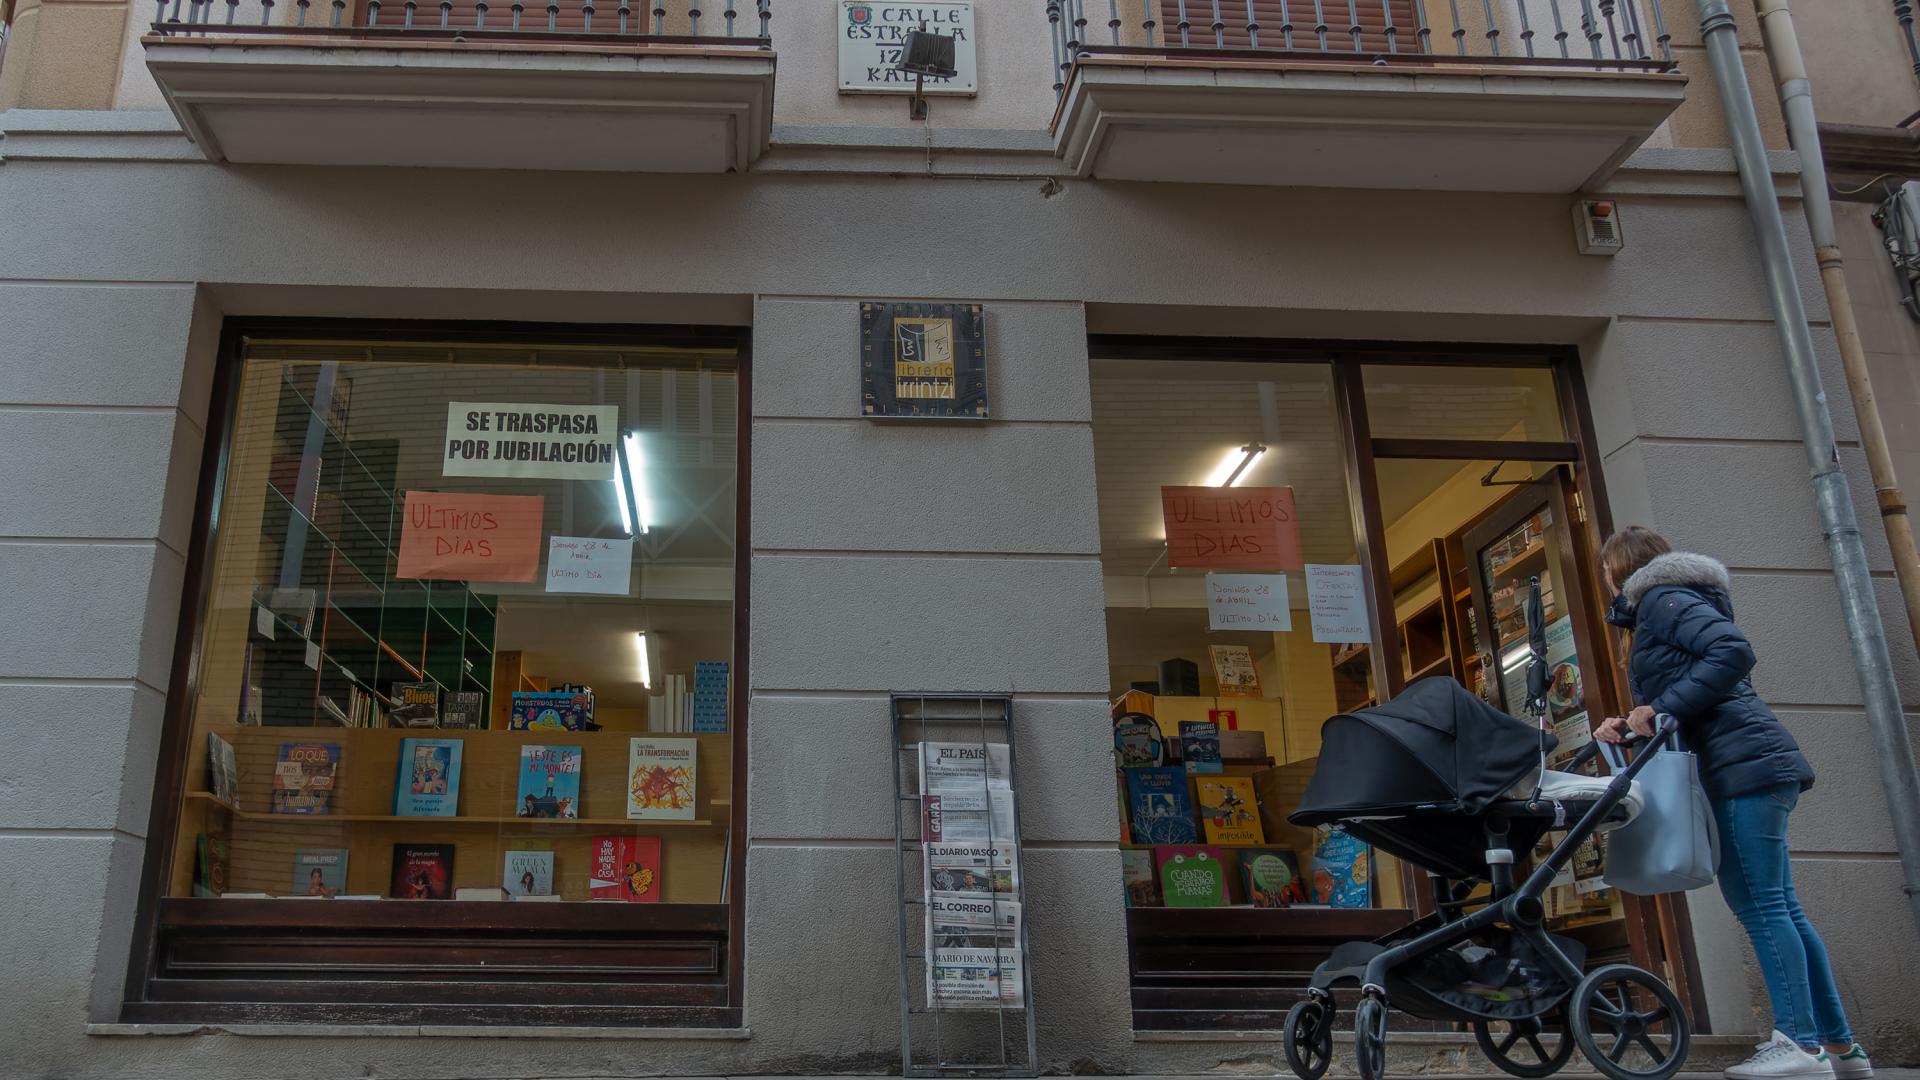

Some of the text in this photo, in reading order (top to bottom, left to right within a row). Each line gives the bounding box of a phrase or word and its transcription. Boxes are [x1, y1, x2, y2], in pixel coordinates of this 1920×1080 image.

[883, 8, 960, 23] CALLE
[897, 377, 954, 399] irrintzi
[466, 411, 598, 434] SE TRASPASA
[449, 439, 612, 463] POR JUBILACIÓN
[1172, 496, 1289, 524] ULTIMOS
[412, 503, 498, 530] ULTIMOS
[1193, 533, 1262, 558] DIAS
[404, 687, 436, 704] Blues
[291, 750, 328, 762] LO QUE
[561, 750, 573, 762] ES
[940, 748, 985, 759] EL PAÍS
[931, 802, 940, 832] GARA
[602, 839, 613, 848] NO
[600, 847, 614, 855] HAY
[940, 848, 969, 856] DIARIO
[970, 849, 998, 857] VASCO
[598, 855, 616, 864] NADIE
[597, 869, 615, 878] CASA
[1171, 869, 1213, 882] CUANDO
[933, 903, 992, 913] EL CORREO
[932, 955, 1015, 964] DIARIO DE NAVARRA
